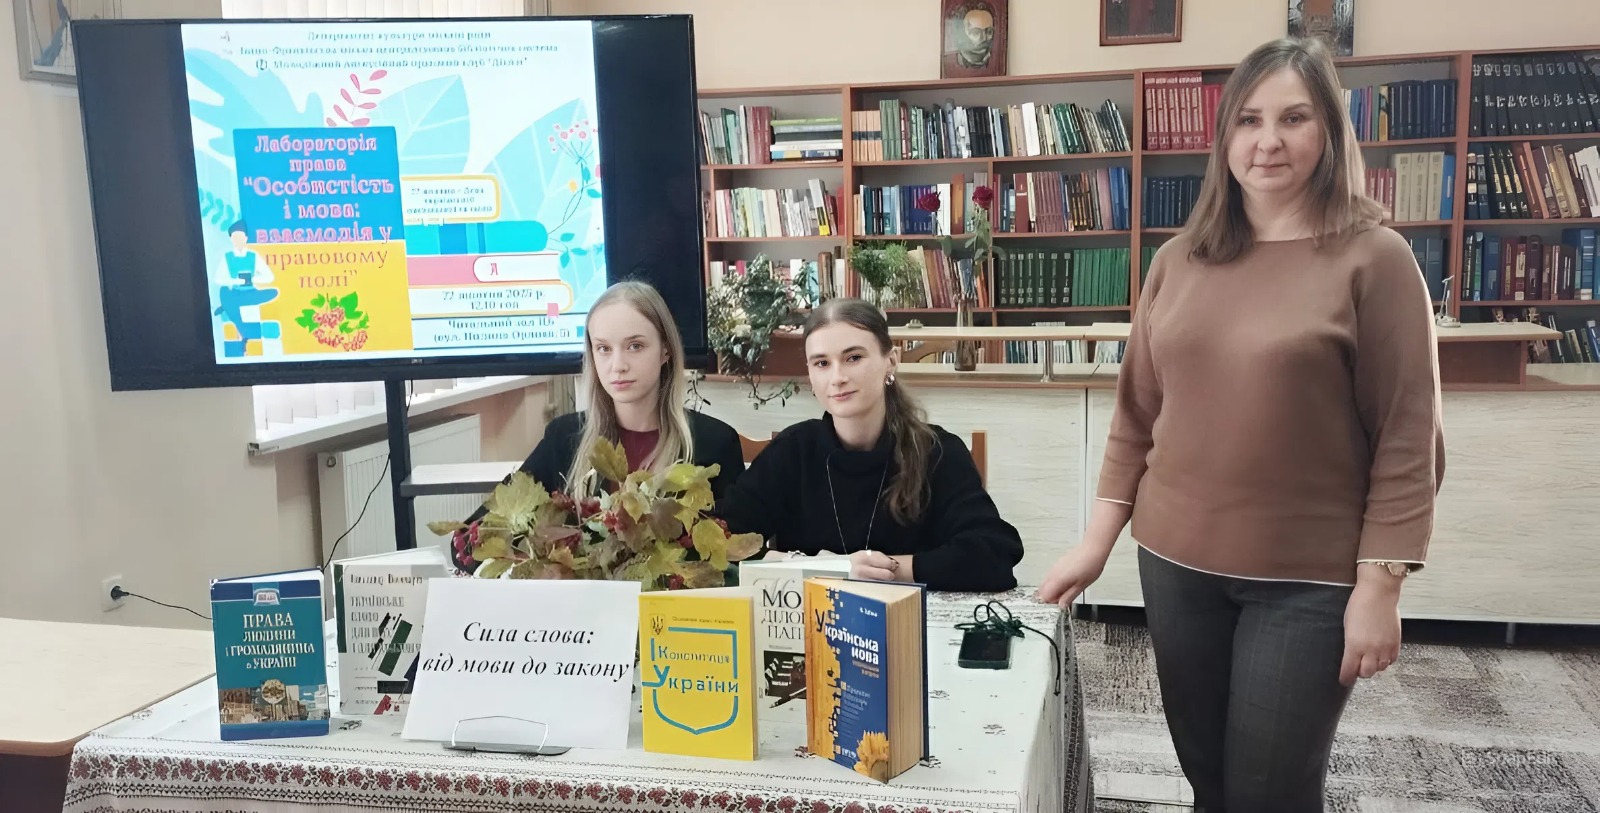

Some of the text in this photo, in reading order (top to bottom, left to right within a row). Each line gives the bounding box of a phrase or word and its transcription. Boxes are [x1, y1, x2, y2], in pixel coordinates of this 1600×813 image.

[254, 133, 377, 156] Лабораторія
[289, 158, 347, 177] права
[283, 198, 360, 219] і мова:
[256, 221, 392, 245] взаємодія у
[265, 250, 388, 269] правовому
[243, 612, 294, 629] ПРАВА
[815, 608, 879, 652] Українська
[243, 629, 296, 643] ЛЮДИНИ
[463, 621, 595, 645] Сила слова:
[253, 656, 296, 670] УКРАЇНІ
[658, 645, 731, 664] Конституція
[422, 652, 631, 683] від мови до закону
[642, 664, 738, 694] України
